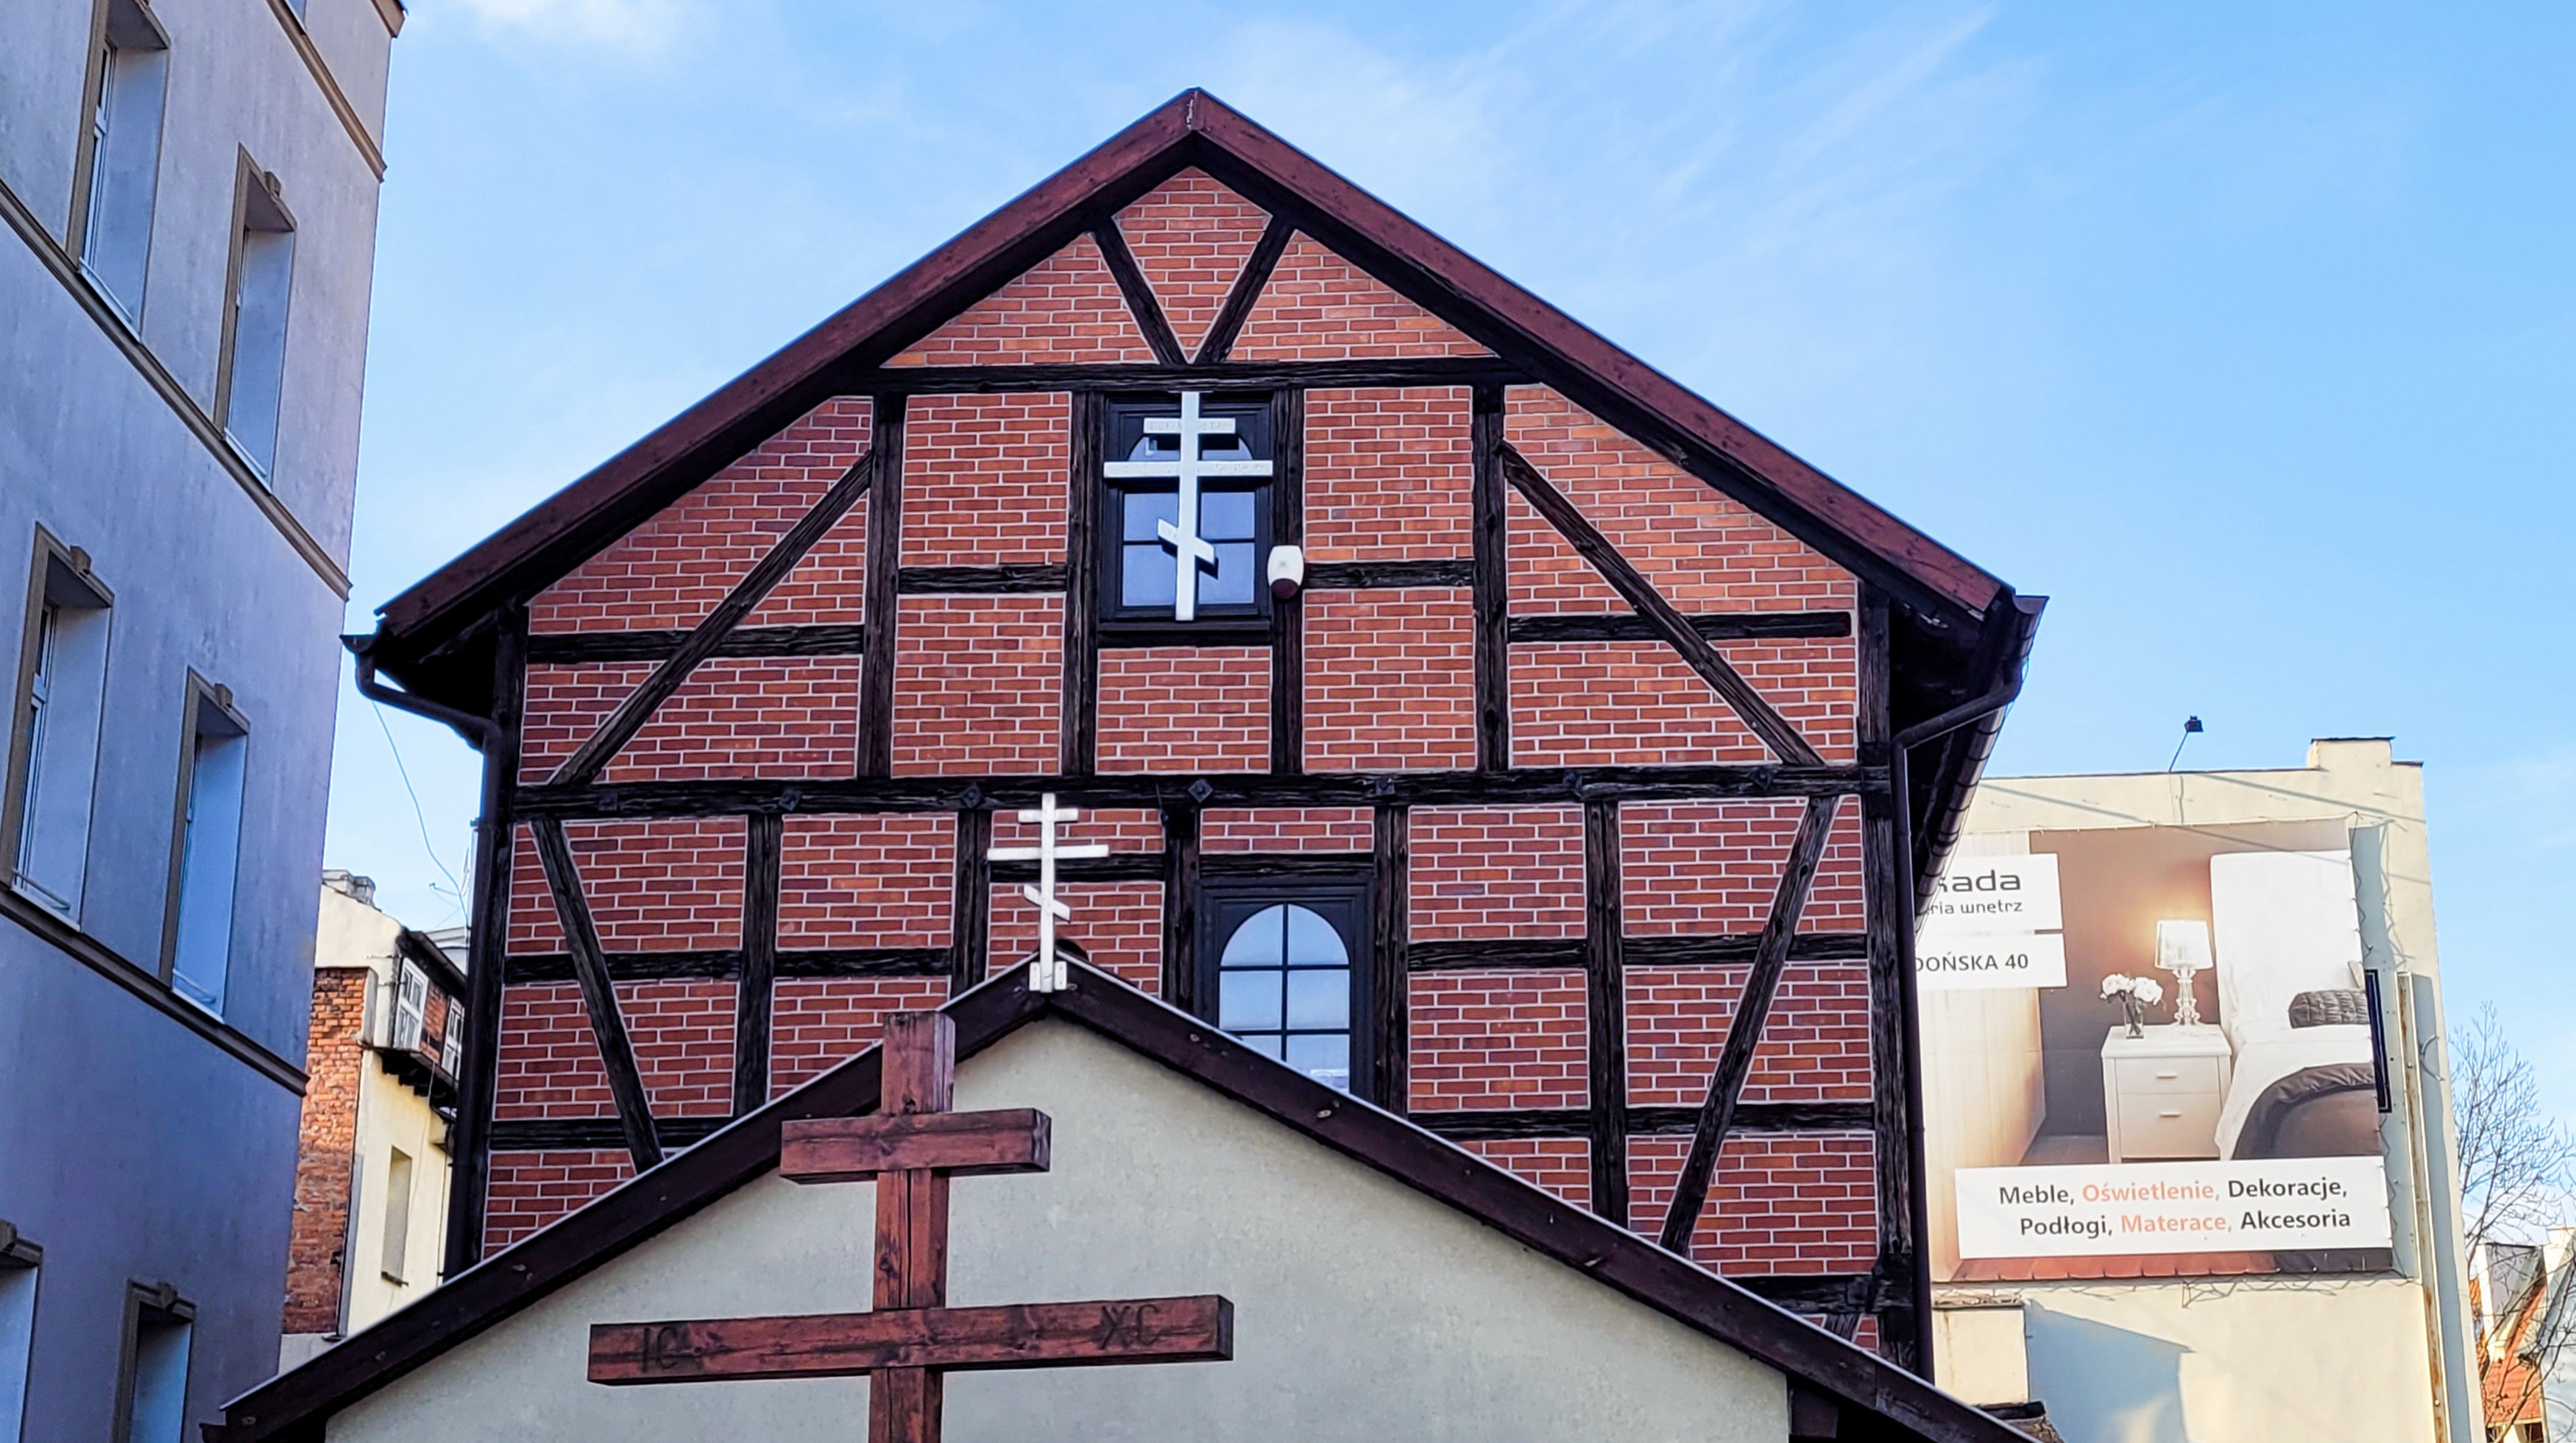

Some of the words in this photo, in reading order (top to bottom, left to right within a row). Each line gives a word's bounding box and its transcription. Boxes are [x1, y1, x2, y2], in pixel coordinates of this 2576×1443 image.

[1961, 899, 2023, 914] wnętrz
[2004, 953, 2029, 970] 40
[1998, 1185, 2076, 1205] Meble,
[2082, 1180, 2221, 1202] Oświetlenie,
[2228, 1176, 2349, 1201] Dekoracje,
[2020, 1215, 2113, 1240] Podłogi,
[2120, 1214, 2233, 1235] Materace,
[2240, 1208, 2352, 1230] Akcesoria
